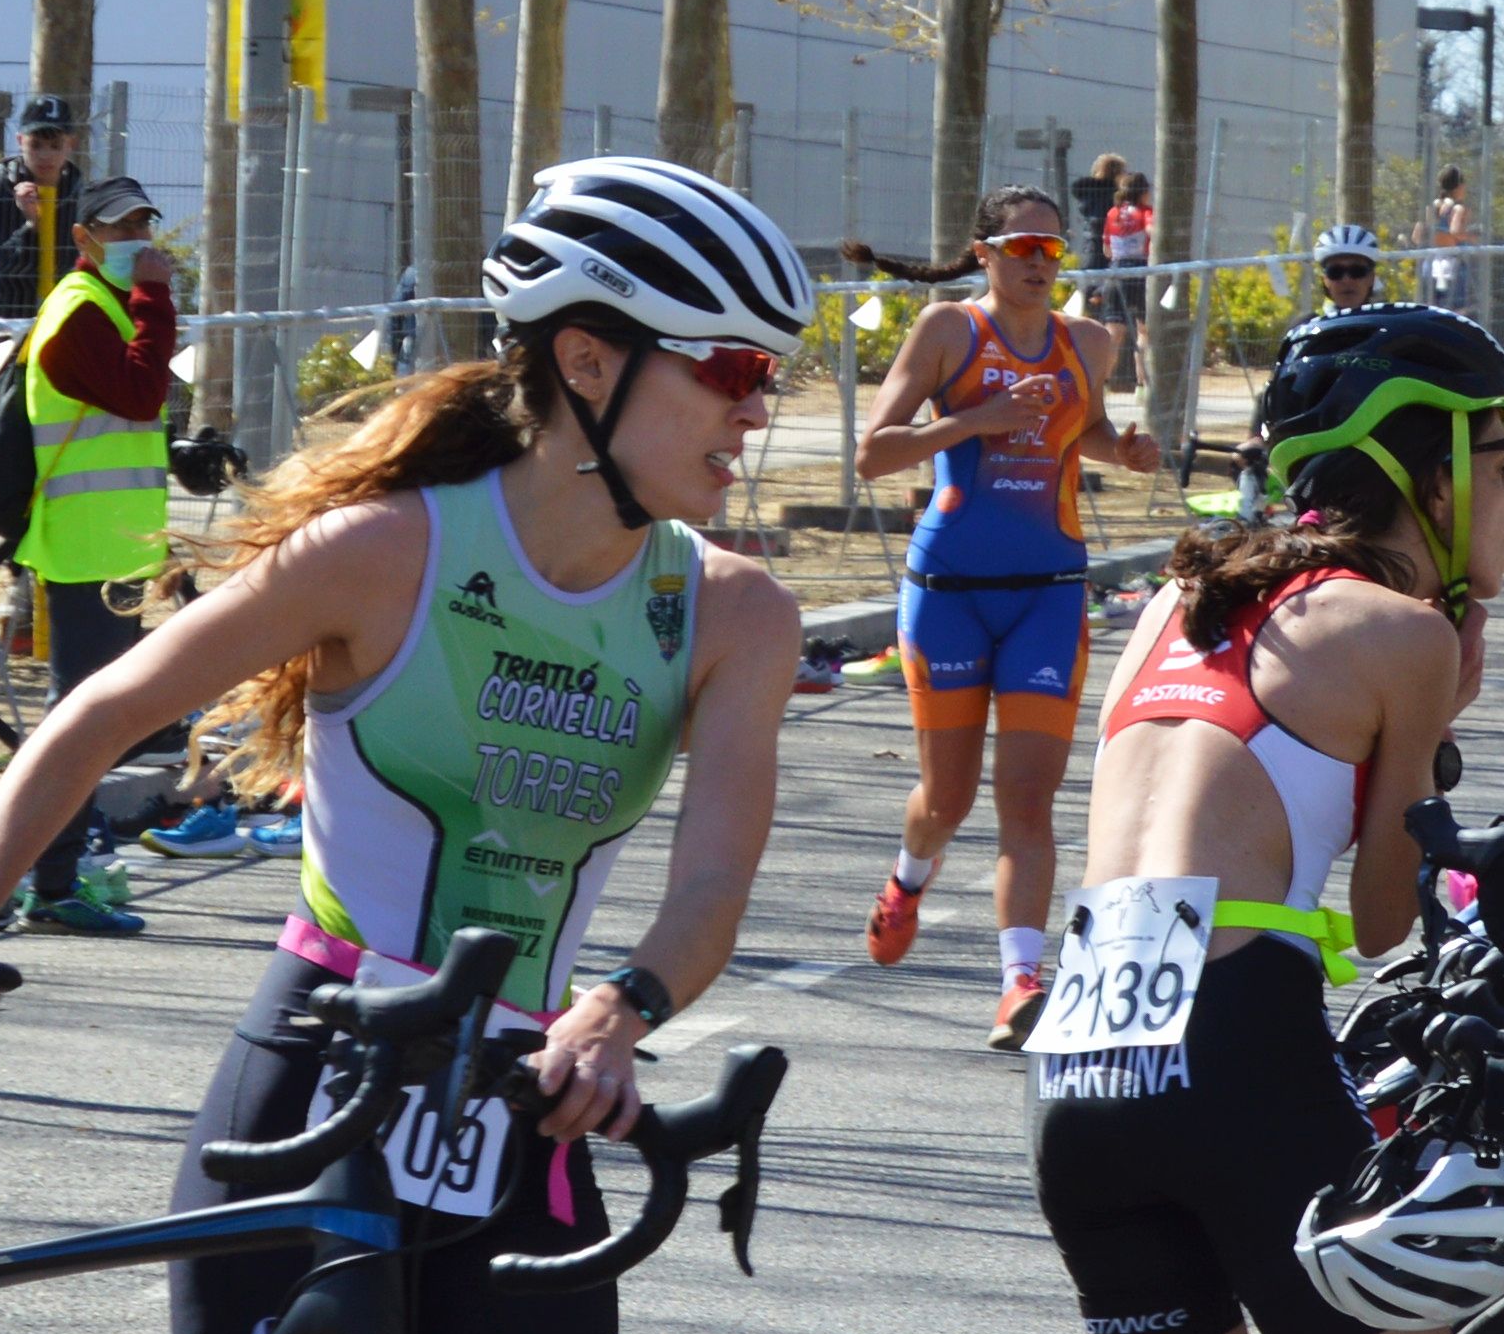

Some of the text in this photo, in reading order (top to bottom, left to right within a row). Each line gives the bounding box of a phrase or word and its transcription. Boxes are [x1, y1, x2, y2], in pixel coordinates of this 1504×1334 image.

[930, 660, 975, 674] PRAT
[477, 675, 642, 749] CORNELLÀ
[1131, 683, 1227, 708] DISTANCE
[471, 743, 621, 827] TORRES
[464, 845, 565, 878] ENINTER
[1057, 960, 1184, 1038] 2139
